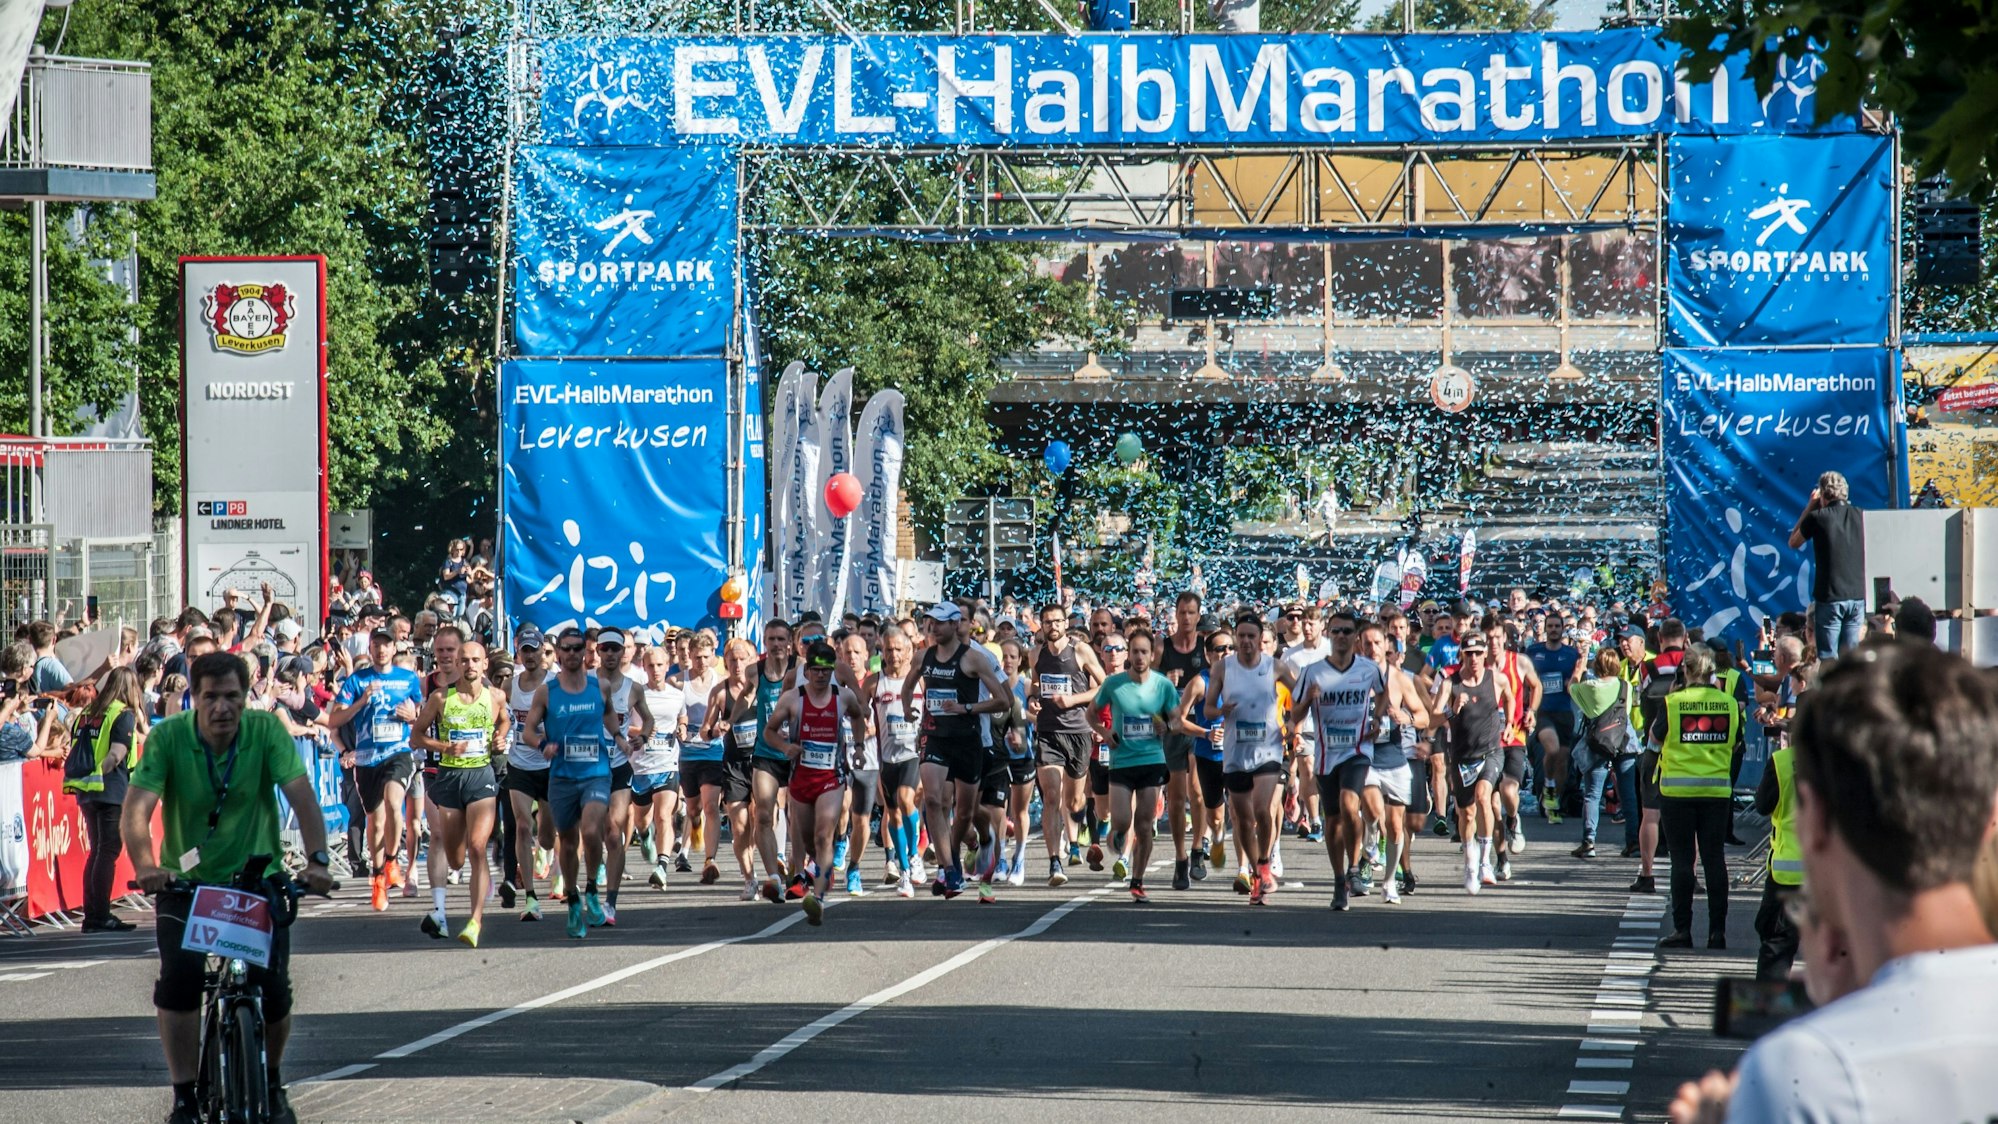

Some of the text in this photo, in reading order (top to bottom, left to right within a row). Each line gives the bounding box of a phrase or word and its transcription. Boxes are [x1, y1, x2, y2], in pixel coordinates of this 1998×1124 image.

[674, 41, 1729, 136] EVL-HalbMarathon
[1690, 250, 1869, 273] SPORTPARK
[537, 259, 715, 284] SPORTPARK
[240, 287, 261, 297] 1904
[221, 336, 280, 350] Leverkusen
[207, 382, 295, 400] NORDOST
[1676, 372, 1876, 392] EVL-HalbMarathon
[515, 384, 714, 404] EVL-HalbMarathon
[1679, 408, 1870, 438] Leverkusen
[519, 420, 708, 450] Leverkusen
[215, 503, 245, 514] P P8
[211, 519, 286, 530] LINDNER HOTEL
[861, 446, 885, 613] HalbMarathon
[1679, 702, 1704, 711] SECURITY
[1709, 702, 1729, 712] SERVICE
[1682, 732, 1727, 742] SECURITAS
[211, 909, 259, 928] Kampfrichter
